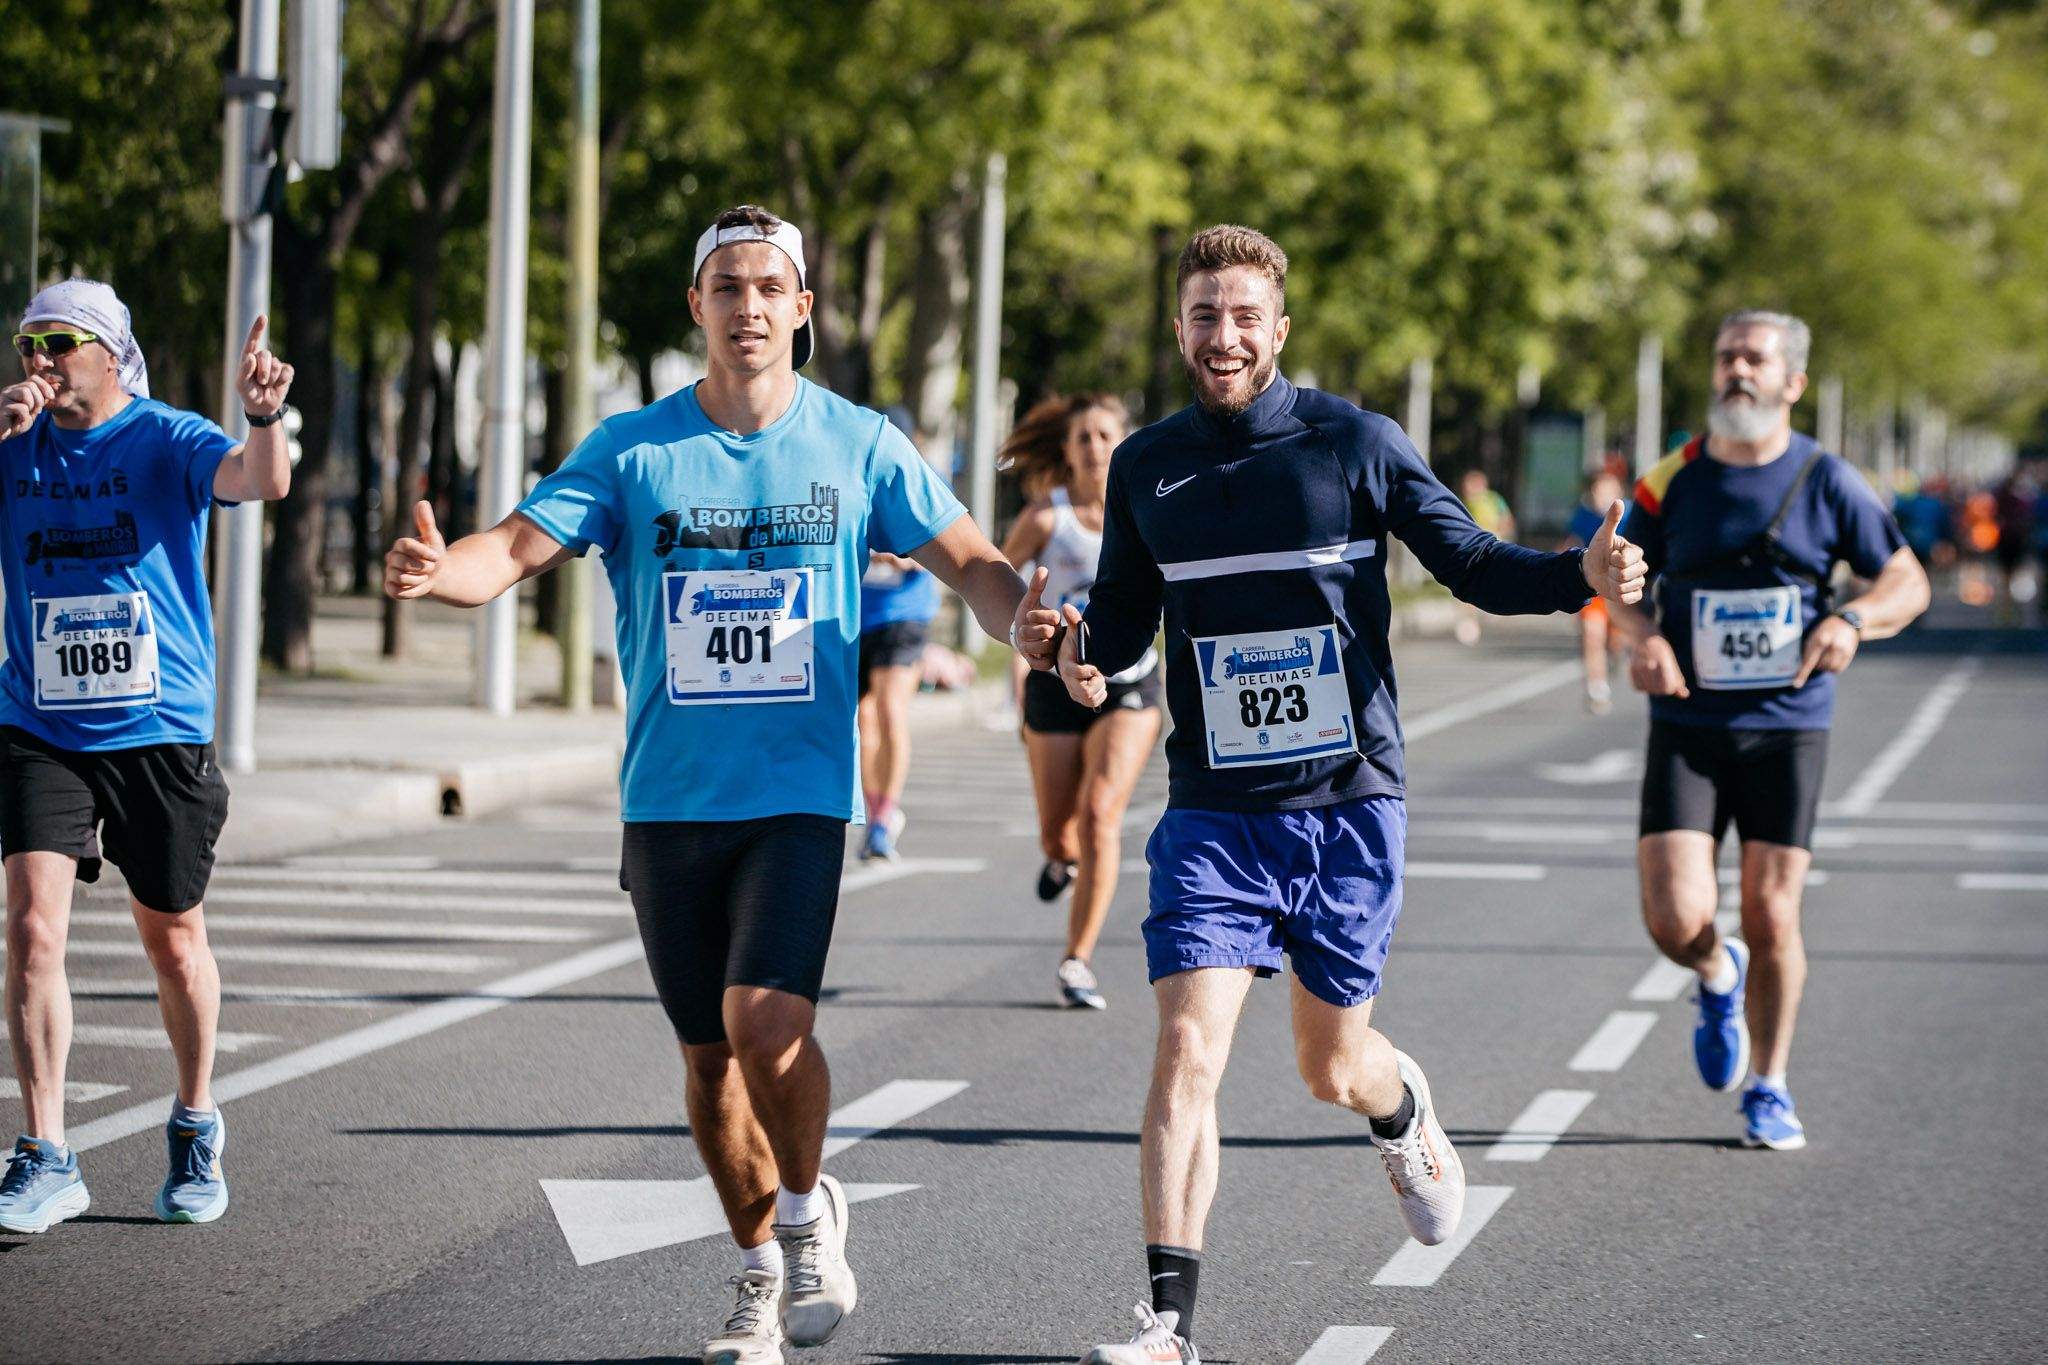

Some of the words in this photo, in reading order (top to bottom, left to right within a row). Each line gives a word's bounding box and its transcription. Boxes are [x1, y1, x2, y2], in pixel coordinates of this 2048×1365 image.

[16, 476, 128, 500] DECMAS
[697, 505, 834, 528] BOMBEROS
[52, 528, 134, 543] BOMBEROS
[749, 527, 768, 546] de
[773, 523, 833, 544] MADRID
[713, 588, 783, 600] BOMBEROS
[69, 611, 129, 622] BOMBEROS
[705, 610, 782, 622] DECIMAS
[64, 629, 129, 641] DECIMAS
[706, 625, 772, 665] 401
[1242, 647, 1309, 663] BOMBEROS
[1721, 632, 1773, 659] 450
[55, 641, 131, 677] 1089
[1238, 668, 1311, 686] DECIMAS
[1238, 684, 1309, 728] 823
